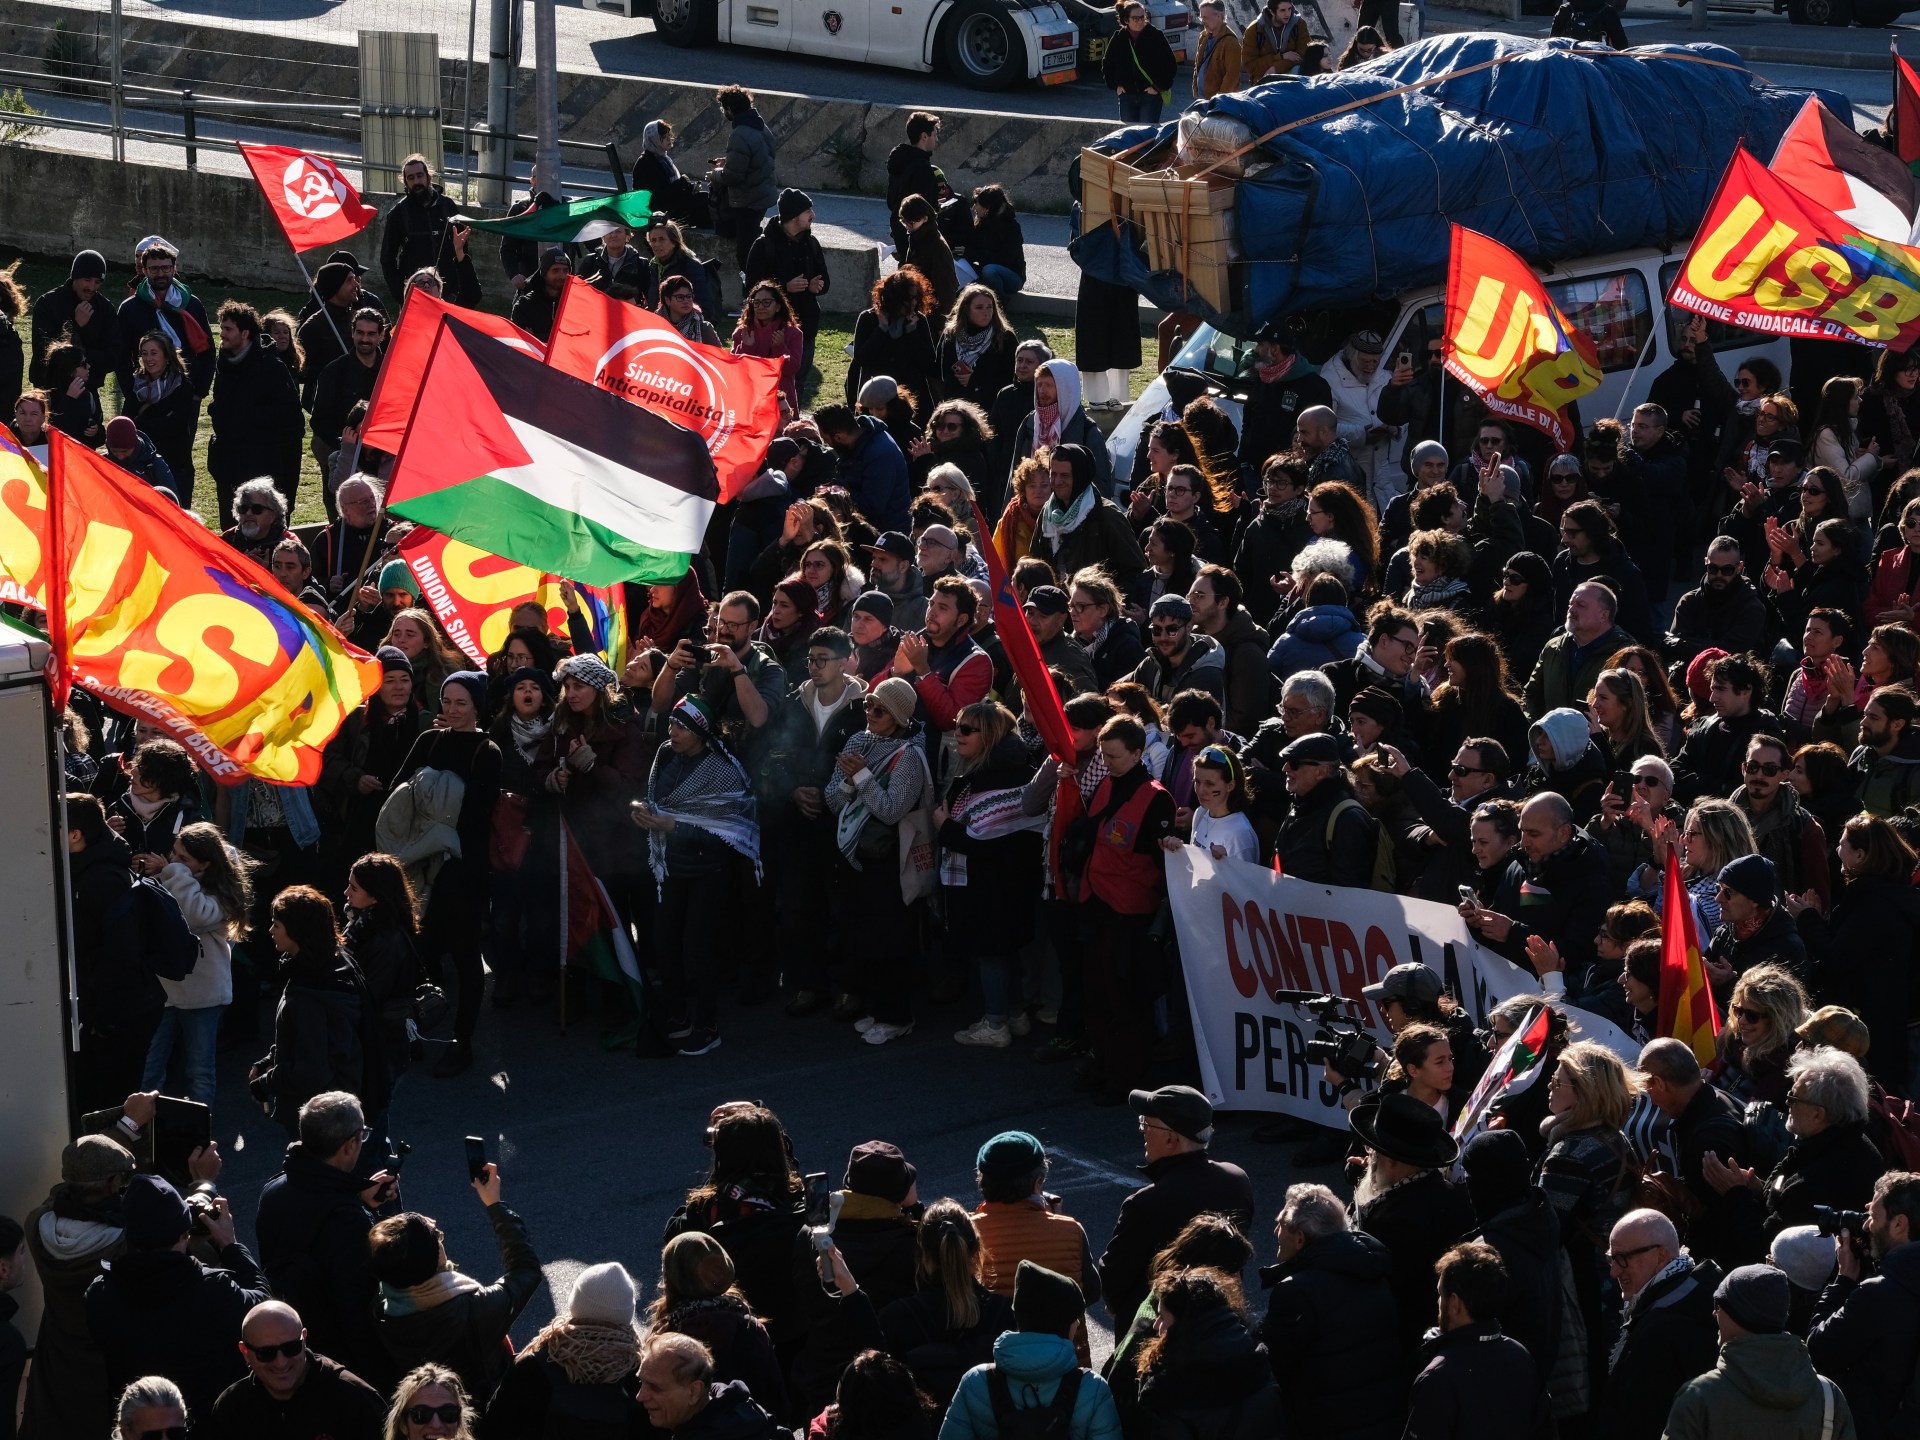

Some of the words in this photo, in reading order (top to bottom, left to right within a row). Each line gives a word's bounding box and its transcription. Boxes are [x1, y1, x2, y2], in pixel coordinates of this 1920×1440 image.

[1688, 194, 1920, 341] USB
[1672, 287, 1733, 321] UNIONE
[1735, 312, 1820, 334] SINDACALE
[1823, 321, 1842, 336] DI
[596, 369, 725, 422] Anticapitalista
[624, 362, 693, 397] Sinistra
[1539, 414, 1551, 429] DI
[412, 555, 458, 621] UNIONE
[165, 716, 196, 733] DI
[185, 732, 240, 776] BASE
[1222, 892, 1398, 1035] CONTRO
